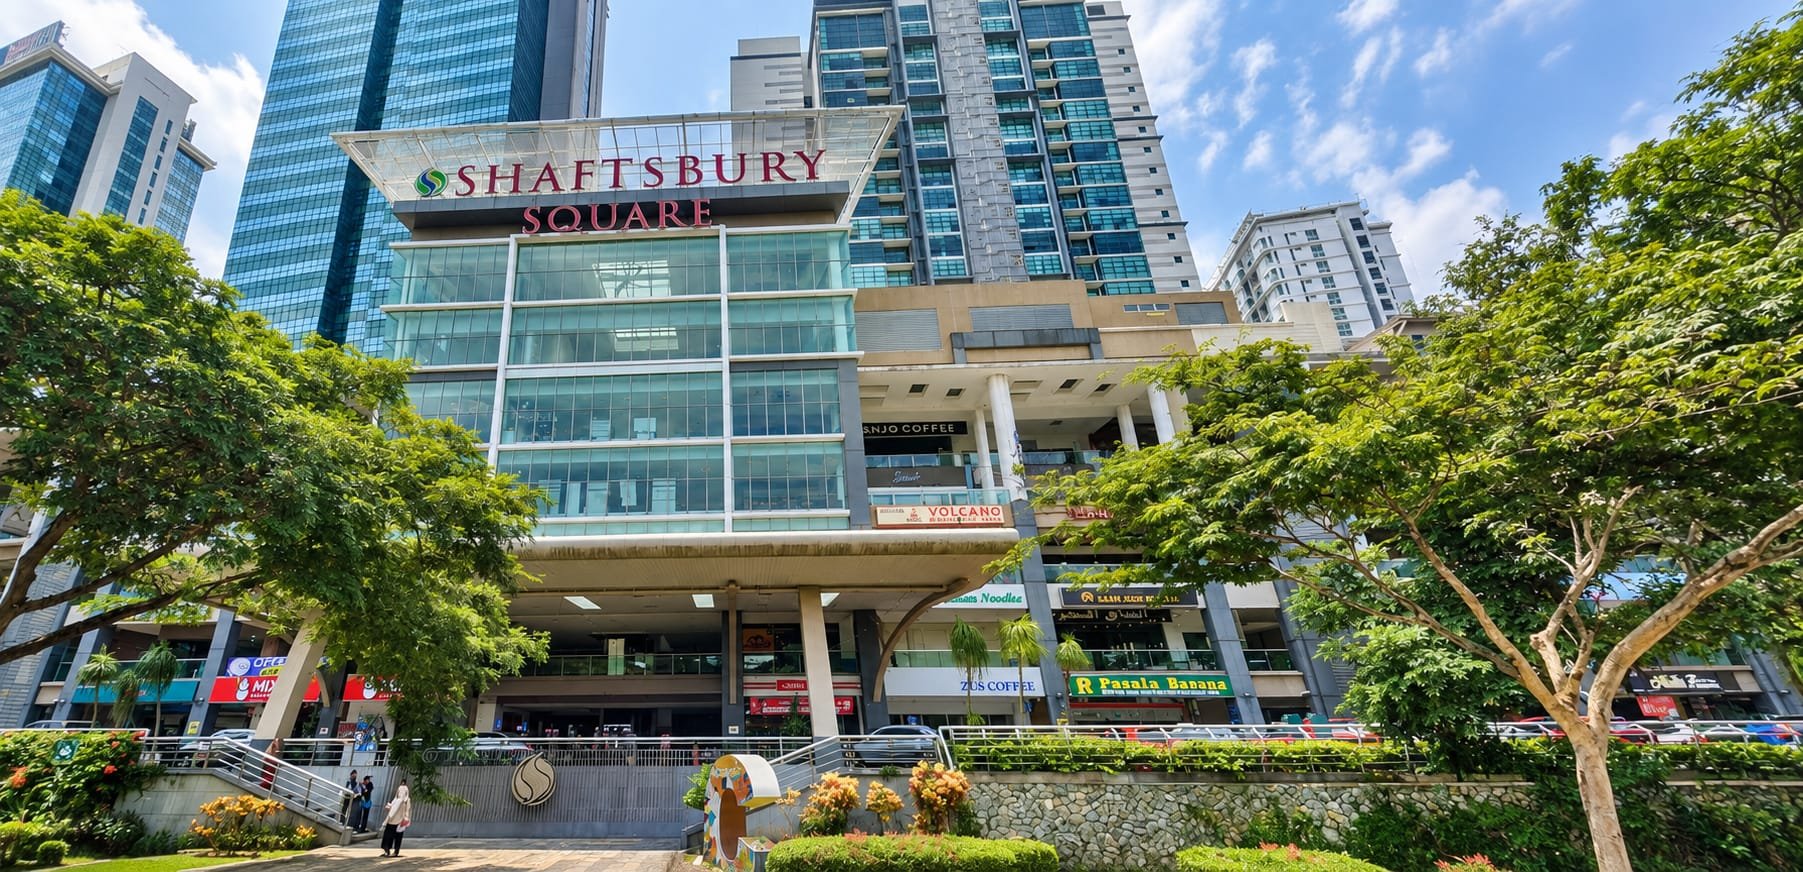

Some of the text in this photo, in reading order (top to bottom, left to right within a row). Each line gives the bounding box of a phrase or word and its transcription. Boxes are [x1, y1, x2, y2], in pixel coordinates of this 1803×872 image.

[455, 149, 826, 197] SHAFTSBURY
[522, 198, 713, 234] SQUARE
[902, 423, 955, 433] COFFEE
[928, 506, 1001, 517] VOLCANO
[960, 681, 1035, 692] ZUS COFFEE
[1075, 677, 1228, 694] R Pasala Banana
